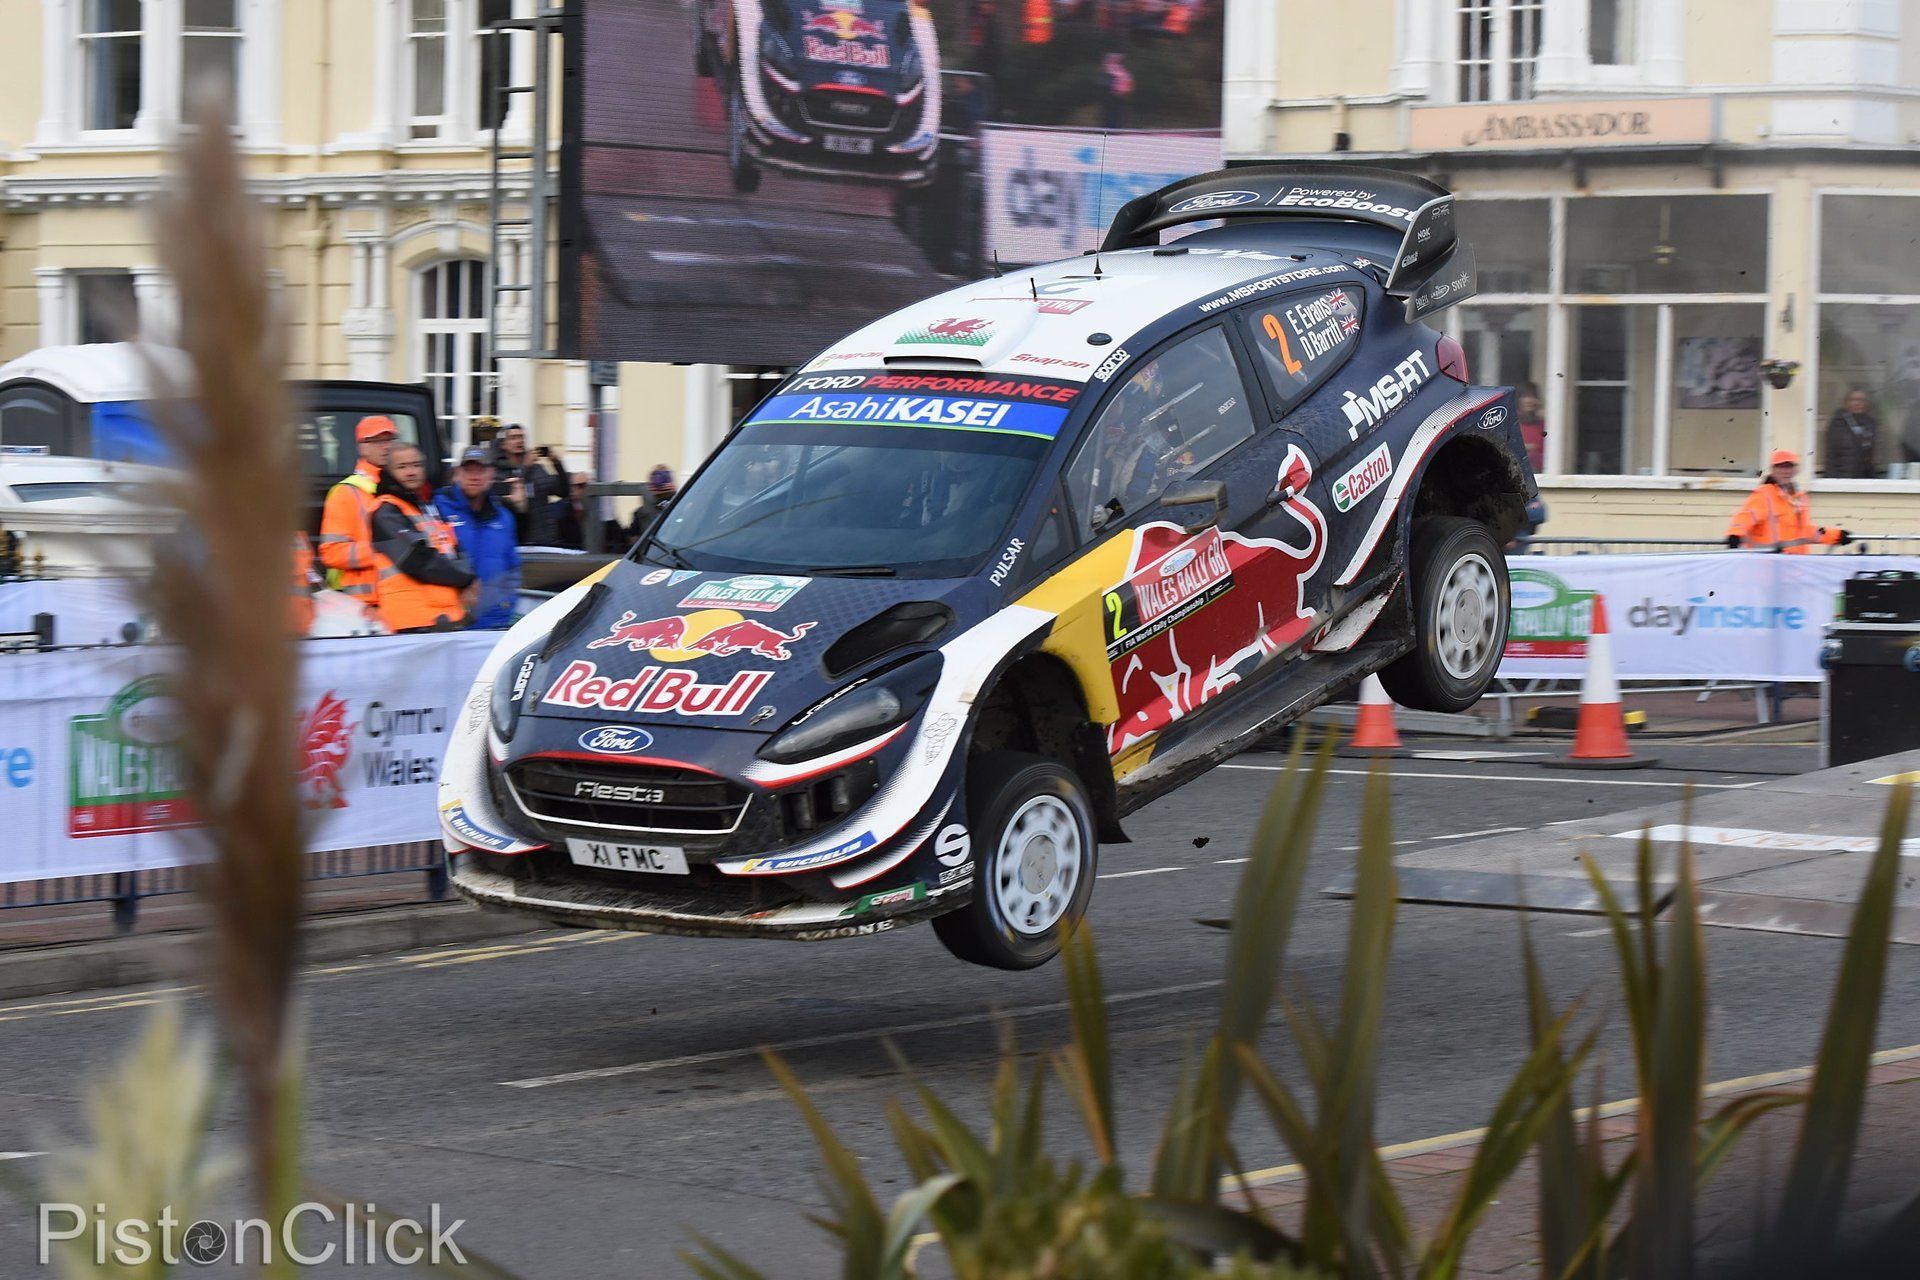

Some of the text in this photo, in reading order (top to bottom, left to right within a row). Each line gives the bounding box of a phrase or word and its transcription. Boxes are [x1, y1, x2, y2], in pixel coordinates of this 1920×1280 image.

[1181, 192, 1244, 209] Ford
[1288, 187, 1377, 200] Powered by
[1417, 227, 1431, 240] NGK
[1198, 263, 1349, 313] www.MSPORTSTORE.com
[1285, 297, 1332, 336] E Evans
[1262, 314, 1303, 375] 2
[1299, 316, 1345, 362] D Barritt
[1010, 353, 1091, 370] Snap-on
[1094, 348, 1131, 382] sparco
[793, 375, 1081, 403] FORD PERFORMANCE
[1482, 406, 1504, 428] Ford
[1348, 449, 1390, 501] Castrol
[988, 537, 1026, 588] PULSAR
[1135, 576, 1180, 620] WALES
[1177, 553, 1211, 598] RALLY
[1207, 536, 1226, 577] GB
[694, 584, 734, 600] WALES
[734, 586, 773, 601] RALLY
[1105, 591, 1128, 641] 2
[1136, 627, 1153, 642] World
[1153, 619, 1168, 633] Rally
[1167, 597, 1205, 624] Championship
[541, 660, 662, 712] Red
[634, 667, 776, 716] Bull
[363, 700, 447, 747] Cymru
[588, 729, 641, 751] Ford
[363, 750, 438, 789] Wales
[574, 781, 665, 803] Fiesta
[453, 817, 504, 848] MICHELIN
[617, 845, 666, 871] FMC
[773, 839, 863, 870] MICHELIN
